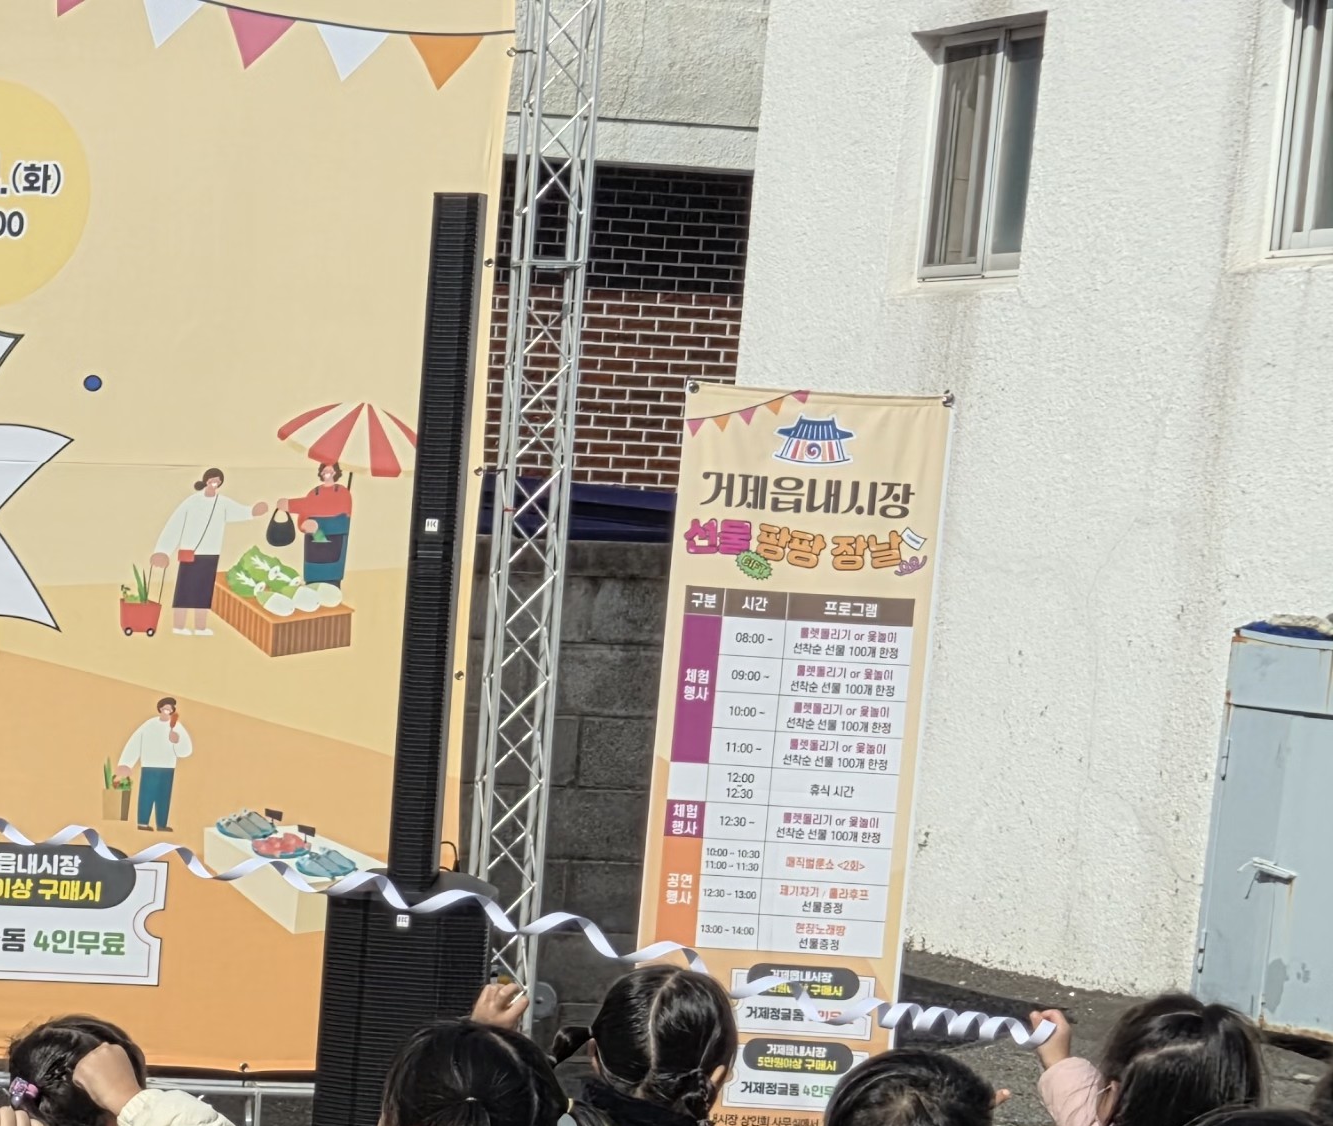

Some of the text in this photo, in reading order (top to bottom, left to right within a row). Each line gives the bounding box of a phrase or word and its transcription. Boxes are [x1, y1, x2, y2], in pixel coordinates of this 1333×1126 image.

[700, 471, 916, 519] 거제읍내시장
[683, 518, 903, 571] 선물 팡팡 장날
[691, 592, 878, 618] 구분 시간 프로그램
[735, 632, 765, 644] 08:00
[854, 633, 864, 641] or
[793, 643, 822, 656] 선착순
[849, 645, 876, 658] 100개
[879, 647, 899, 660] 한정
[731, 669, 761, 681] 09:00
[850, 670, 860, 679] or
[683, 685, 709, 701] 행사
[790, 681, 818, 693] 선착순
[845, 682, 872, 695] 100개
[875, 684, 895, 698] 한정
[729, 706, 757, 717] 10:00
[846, 707, 856, 716] or
[786, 718, 815, 730] 선착순
[840, 719, 868, 732] 100개
[871, 721, 891, 734] 한정
[726, 742, 753, 754] 11:00
[842, 744, 853, 752] or
[783, 754, 811, 767] 선착순
[837, 756, 865, 769] 100개
[868, 758, 888, 771] 한정
[727, 772, 755, 784] 12:00
[726, 787, 753, 799] 12:30
[810, 784, 854, 798] 휴식 시간
[673, 803, 697, 818] 체험
[671, 820, 698, 835] 행사
[719, 816, 746, 827] 12:30
[835, 818, 846, 826] or
[776, 827, 805, 839] 선착순
[831, 830, 858, 842] 100개
[861, 831, 881, 844] 한정
[706, 848, 728, 858] 10:00
[737, 849, 760, 859] 10:30
[704, 860, 727, 870] 11:00
[736, 861, 759, 872] 11:30
[667, 873, 692, 888] 공연
[37, 880, 102, 902] 구매시
[703, 888, 725, 898] 12:30
[734, 890, 757, 900] 13:00
[802, 901, 843, 914] 선물증정
[700, 925, 723, 934] 13:00
[732, 926, 755, 936] 14:00
[33, 929, 126, 956] 4인무료
[741, 1115, 770, 1126] 상인회
